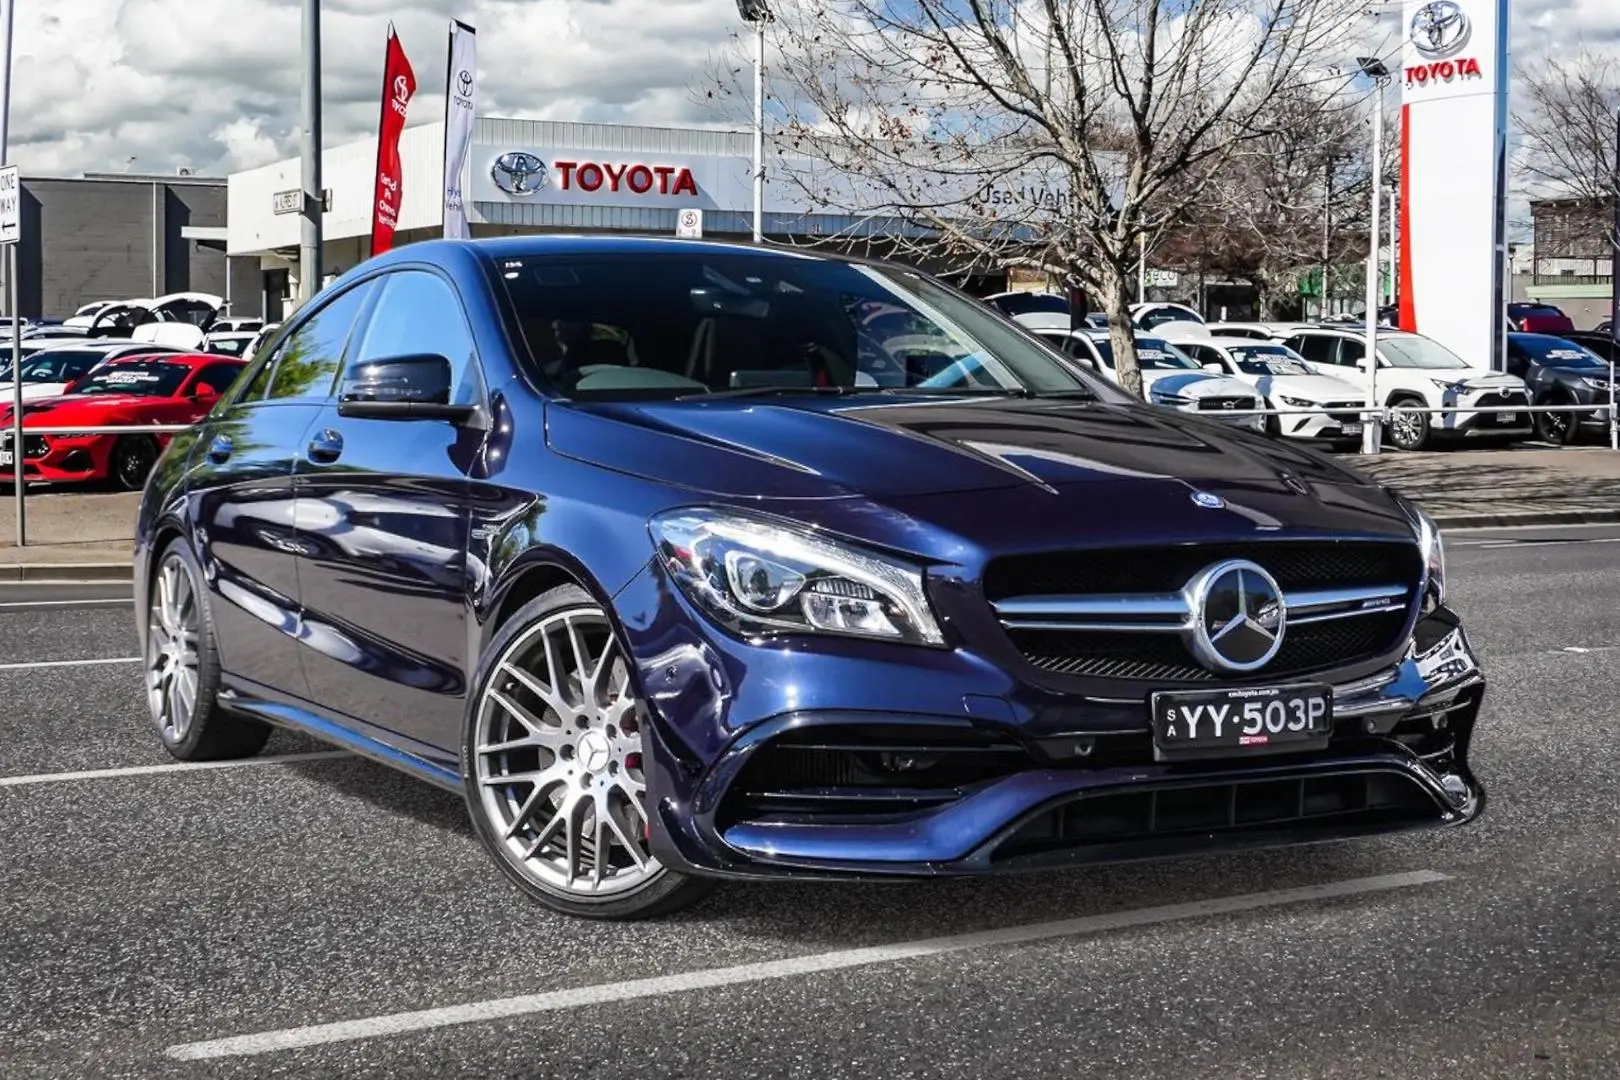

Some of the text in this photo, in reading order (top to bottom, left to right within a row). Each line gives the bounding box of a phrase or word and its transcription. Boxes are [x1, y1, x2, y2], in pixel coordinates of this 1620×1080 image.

[1404, 58, 1480, 83] TOYOTA
[1, 173, 15, 191] ONE
[555, 162, 698, 196] TOYOTA
[0, 196, 16, 213] WAY
